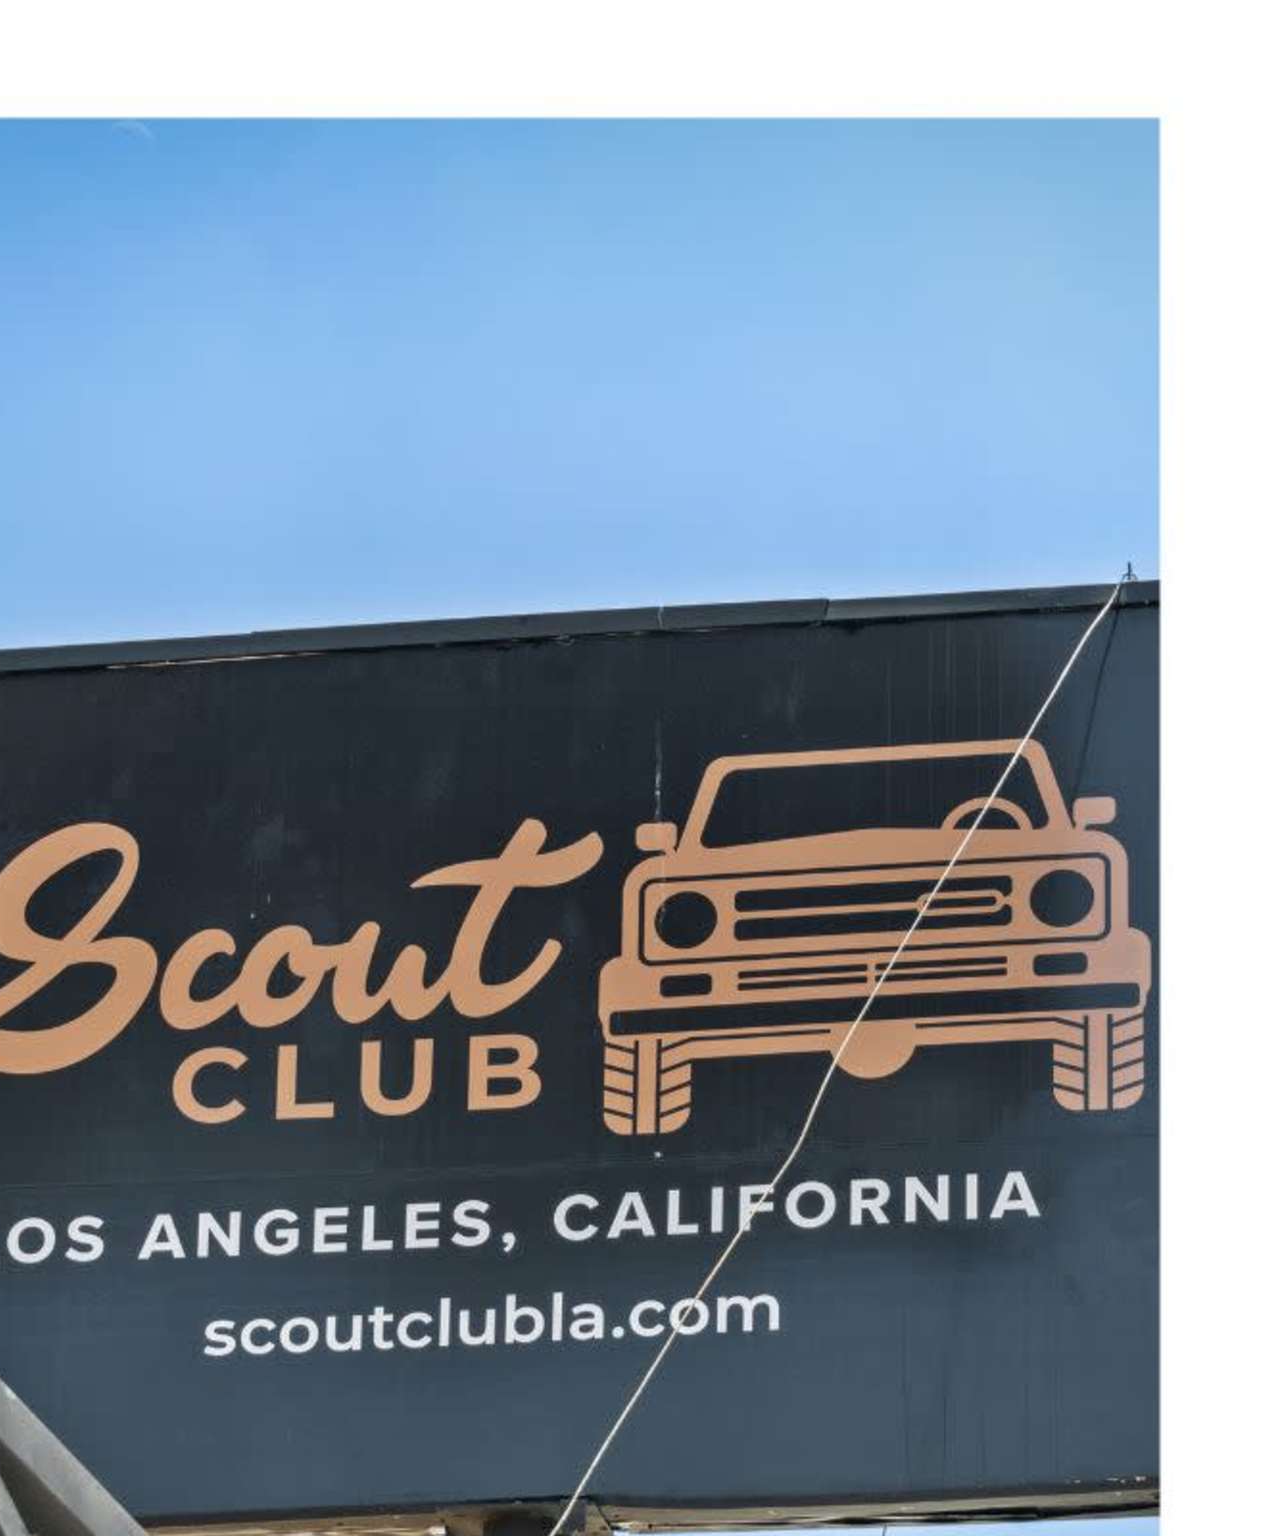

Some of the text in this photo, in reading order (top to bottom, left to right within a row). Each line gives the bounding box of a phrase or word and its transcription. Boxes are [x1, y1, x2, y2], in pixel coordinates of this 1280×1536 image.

[172, 1033, 543, 1125] CLUB
[138, 1197, 519, 1261] ANGELES,
[551, 1169, 1043, 1242] CALIFORNIA
[202, 1286, 783, 1359] scoutclubla.com
